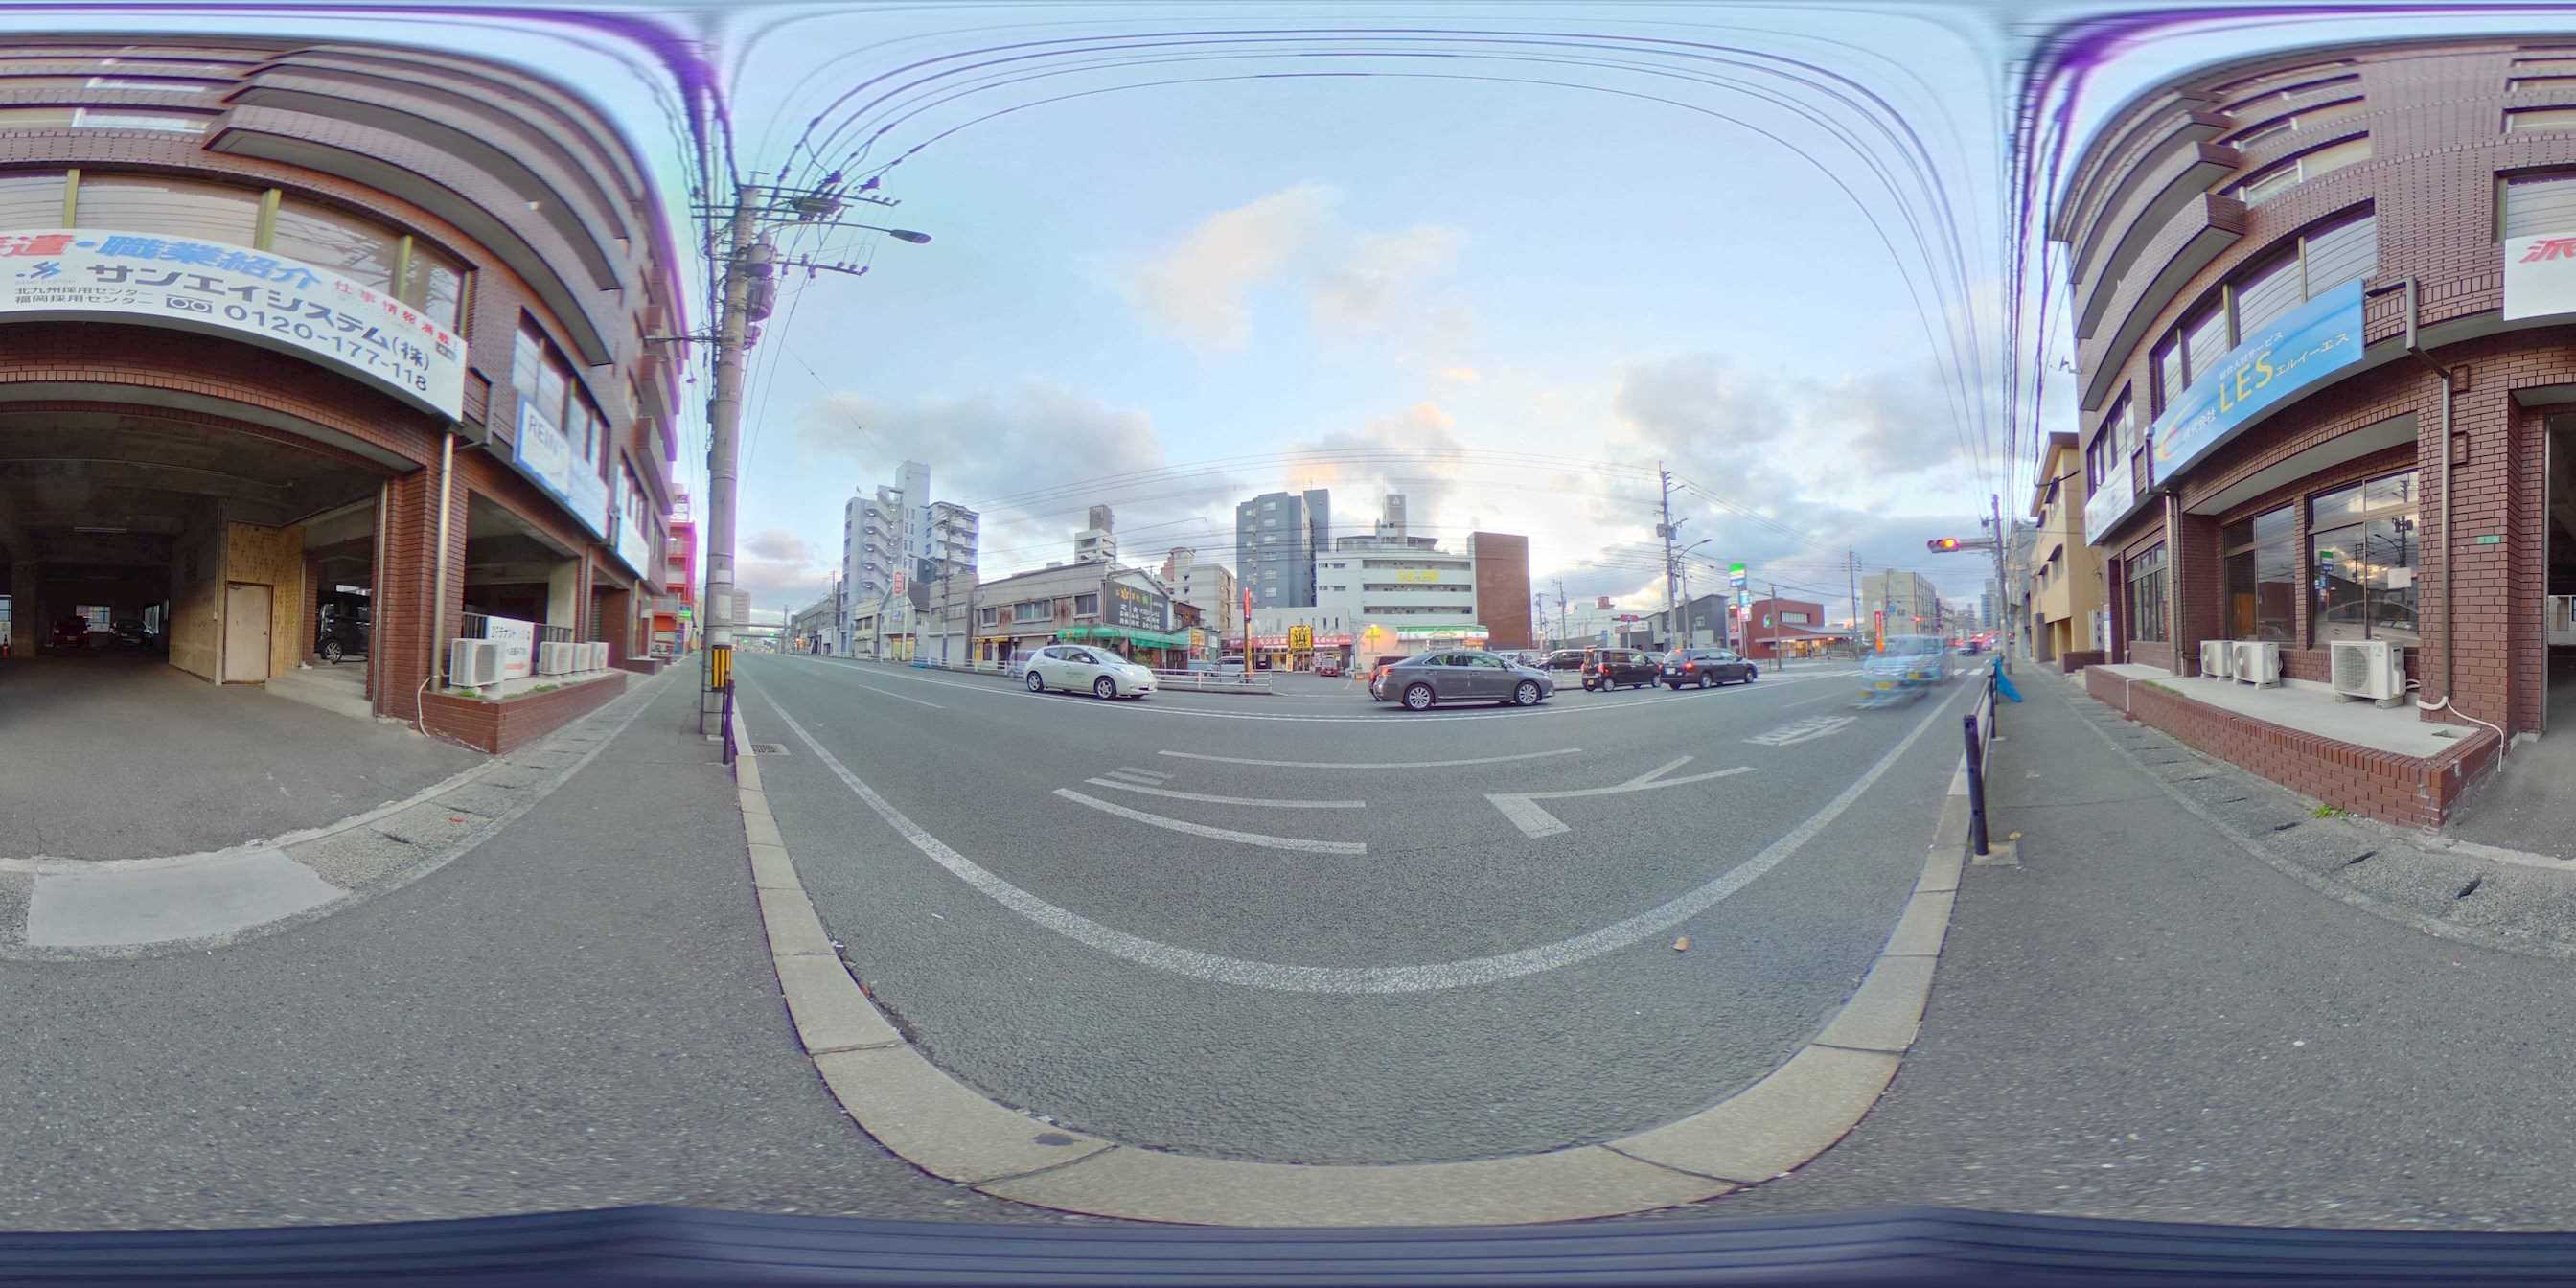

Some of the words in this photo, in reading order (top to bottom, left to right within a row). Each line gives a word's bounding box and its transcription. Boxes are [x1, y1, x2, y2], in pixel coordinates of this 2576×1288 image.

[224, 304, 427, 391] 0120-177-118
[2276, 332, 2350, 377] エルイーエス
[2219, 349, 2274, 414] LES
